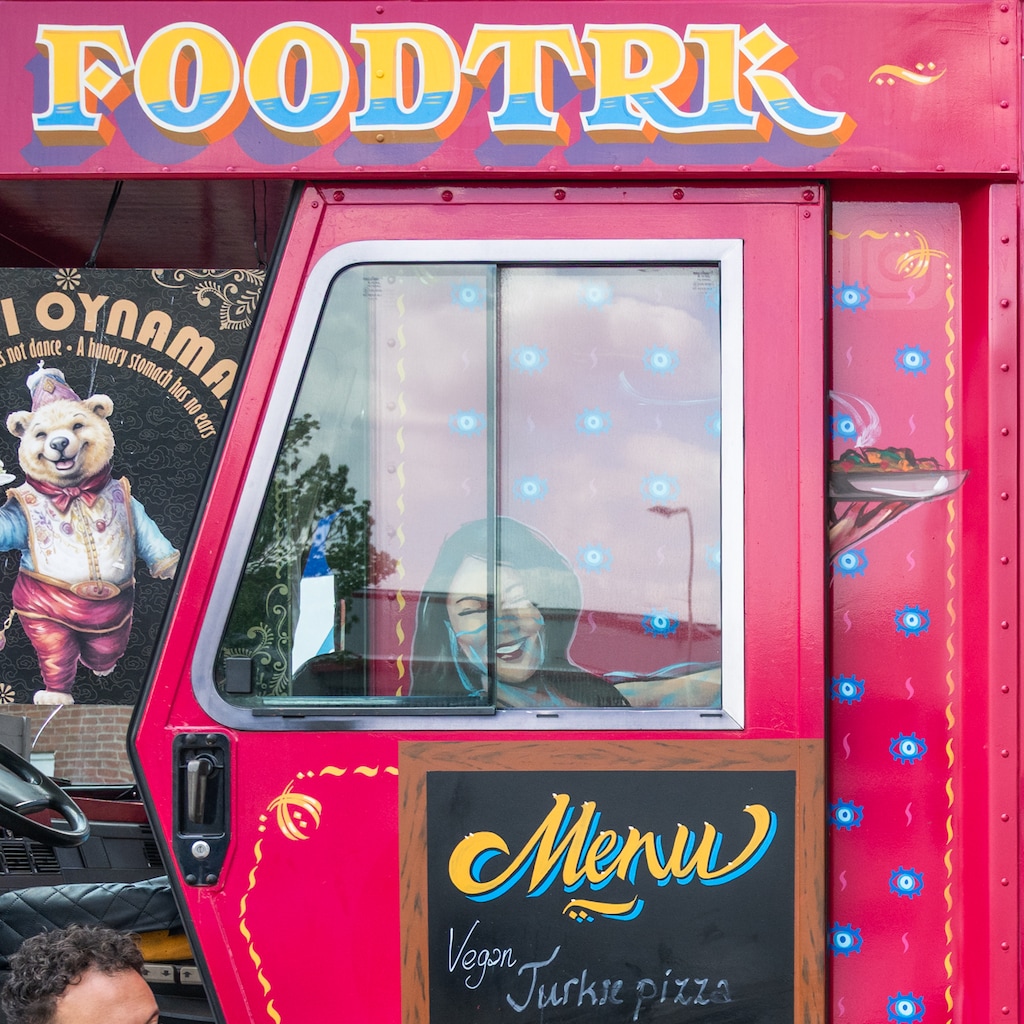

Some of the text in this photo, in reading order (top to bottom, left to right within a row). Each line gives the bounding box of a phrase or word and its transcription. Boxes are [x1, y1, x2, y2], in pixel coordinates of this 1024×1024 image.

[33, 22, 855, 146] FOODTRK
[6, 342, 27, 363] not
[29, 338, 62, 359] dance
[76, 335, 85, 356] A
[87, 337, 128, 367] hungry
[127, 353, 173, 388] stomach
[168, 376, 191, 402] has
[183, 397, 202, 415] no
[194, 412, 216, 439] ears
[36, 292, 239, 409] OYNAMA
[448, 794, 778, 902] Menu
[448, 920, 517, 989] Vegan
[633, 968, 733, 1022] pizza
